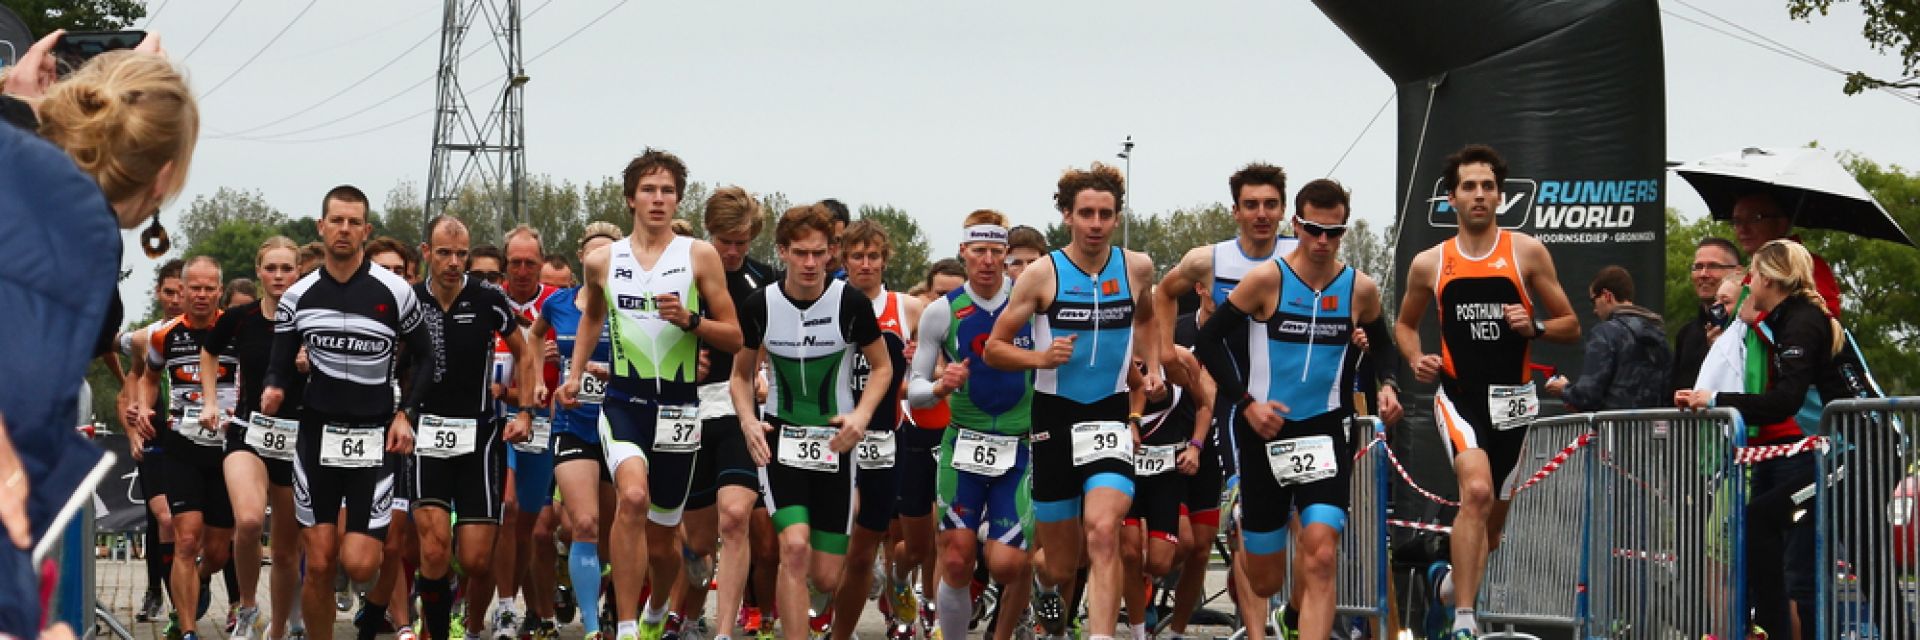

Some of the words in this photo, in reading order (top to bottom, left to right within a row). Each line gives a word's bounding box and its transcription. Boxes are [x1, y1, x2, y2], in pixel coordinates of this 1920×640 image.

[1537, 180, 1658, 204] RUNNERS
[1535, 205, 1635, 228] WORLD
[1456, 303, 1505, 320] POSTHUM
[1471, 322, 1499, 340] NED
[309, 333, 346, 350] CYCLE
[347, 335, 385, 352] TREND
[583, 376, 605, 395] 63
[263, 431, 286, 450] 98
[433, 429, 456, 449] 59
[672, 422, 694, 443] 37
[1093, 432, 1118, 451] 39
[341, 437, 364, 457] 64
[797, 441, 820, 461] 36
[858, 443, 879, 460] 38
[973, 445, 996, 466] 65
[1136, 457, 1164, 472] 102
[1289, 453, 1315, 474] 32
